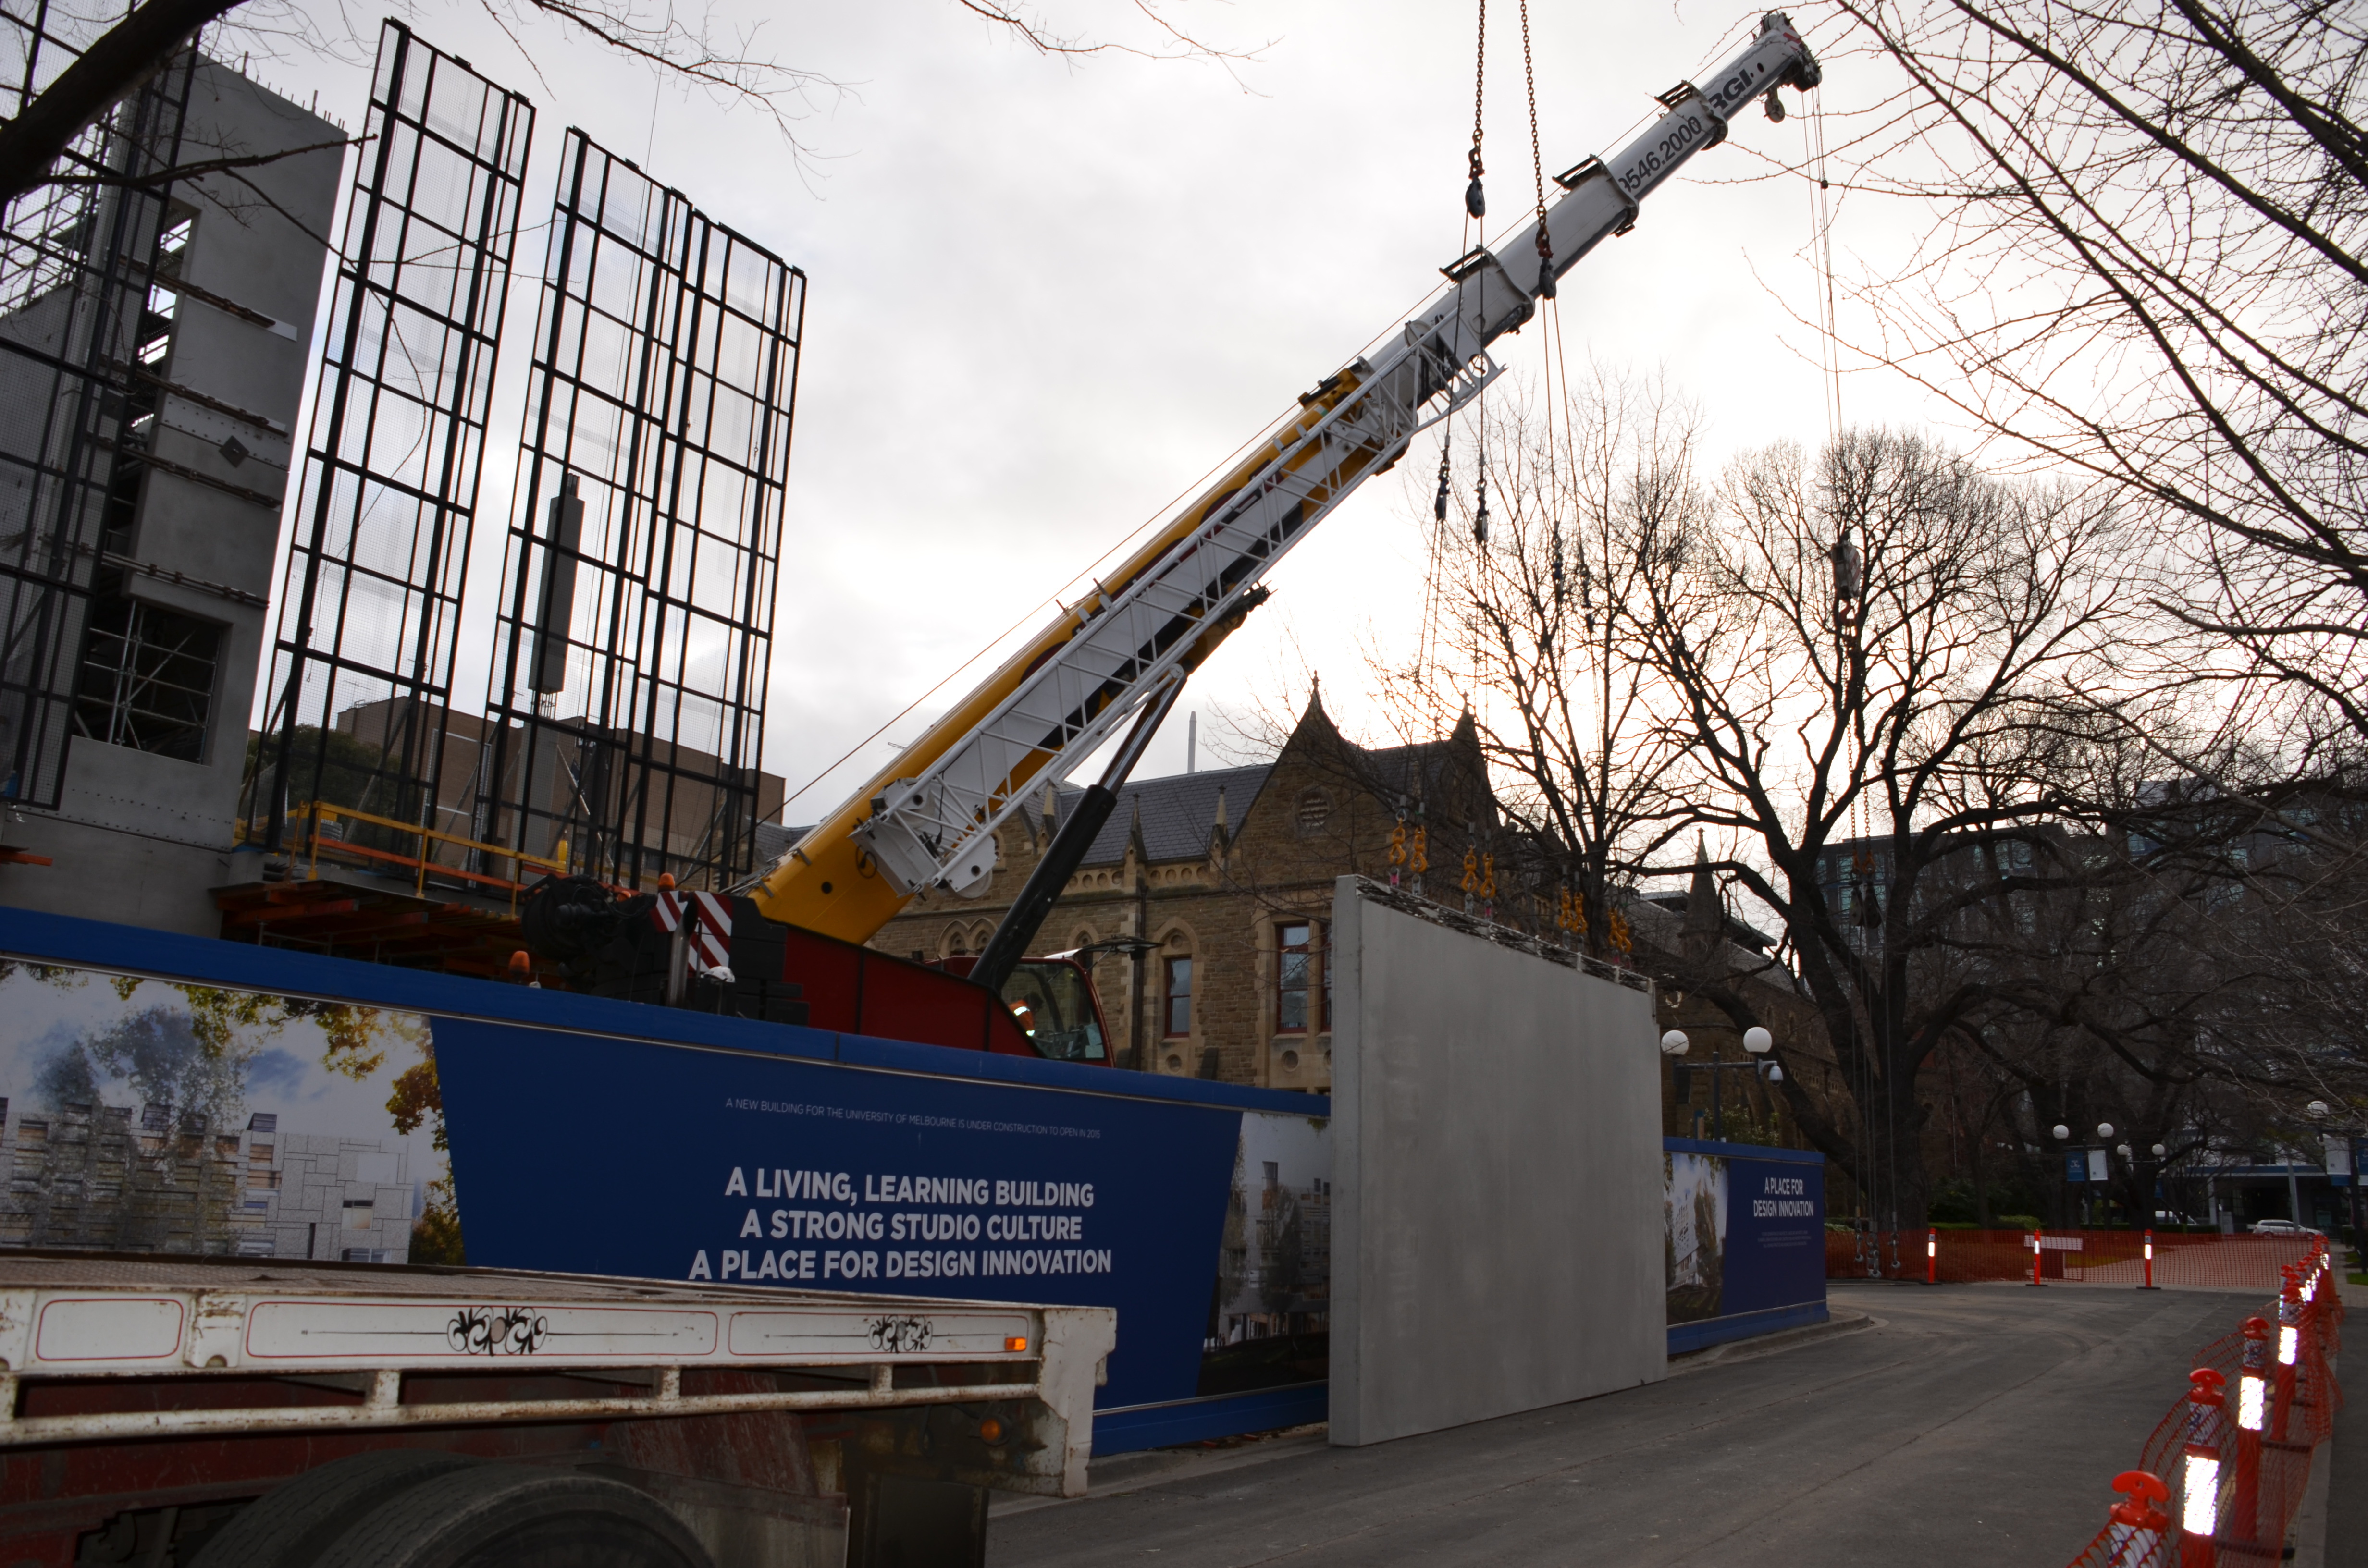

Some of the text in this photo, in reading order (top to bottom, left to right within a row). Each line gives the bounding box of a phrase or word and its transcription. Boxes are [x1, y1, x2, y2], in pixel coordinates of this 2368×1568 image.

[726, 1097, 1100, 1139] A NEW BUILDING FOR THE UNIVERSITY OF MELBOURNE IS UNDER CONSTRUCTION TO OPEN IN 2015
[725, 1166, 1094, 1208] A LIVING, LEARNING BUILDING
[1765, 1177, 1803, 1195] A PLACE FOR
[1754, 1200, 1813, 1216] DESIGN INNOVATION
[740, 1208, 1082, 1241] A STRONG STUDIO CULTURE
[688, 1249, 1111, 1280] A PLACE FOR DESIGN INNOVATION
